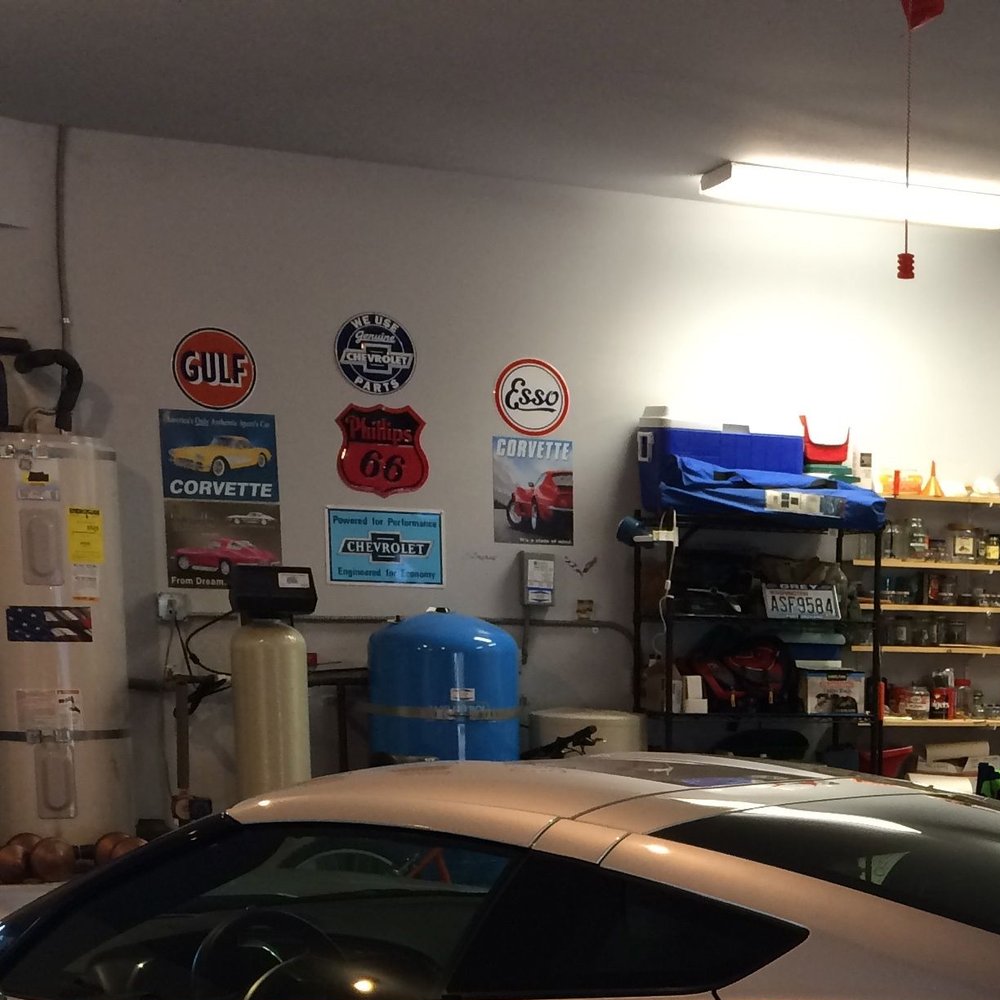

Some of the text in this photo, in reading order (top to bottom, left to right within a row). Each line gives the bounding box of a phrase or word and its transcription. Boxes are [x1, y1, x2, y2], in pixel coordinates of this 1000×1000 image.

[351, 316, 399, 333] WE USE
[346, 352, 407, 365] CHEVROLET
[181, 351, 248, 388] GULF
[354, 376, 399, 393] PARTS
[505, 377, 559, 412] Esso
[495, 439, 570, 460] CORVETTE
[361, 450, 405, 482] 66
[170, 480, 272, 498] CORVETTE
[333, 515, 437, 528] Powered for Performance
[346, 541, 425, 554] CHEVROLET
[338, 567, 381, 577] Engineered
[171, 576, 194, 586] From
